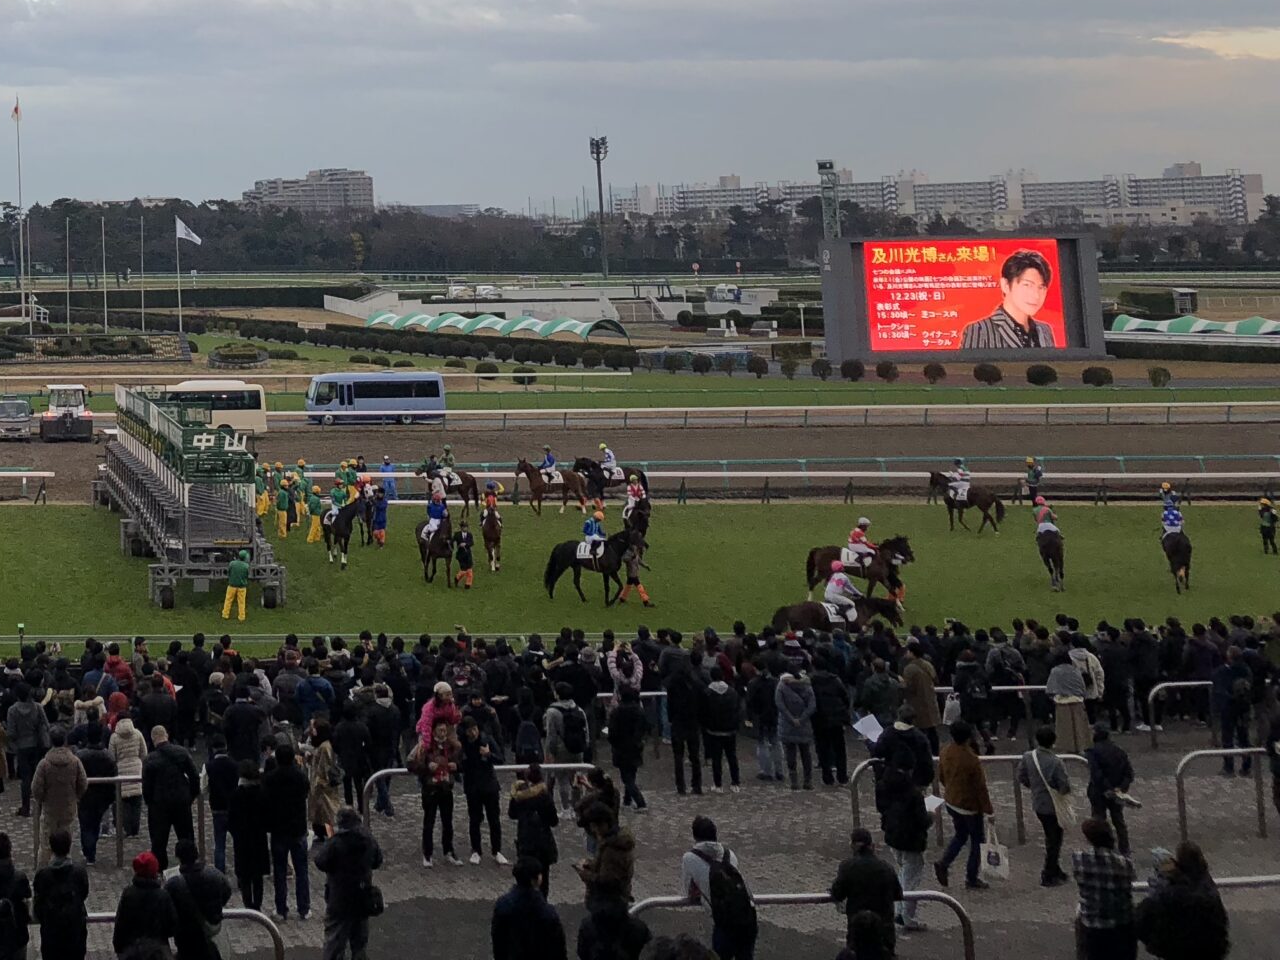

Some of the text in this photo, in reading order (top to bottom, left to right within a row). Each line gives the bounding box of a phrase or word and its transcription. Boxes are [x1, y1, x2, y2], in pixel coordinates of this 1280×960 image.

[872, 246, 996, 264] 及川光博さん来場!
[192, 432, 248, 452] 中山
[578, 544, 588, 554] 11
